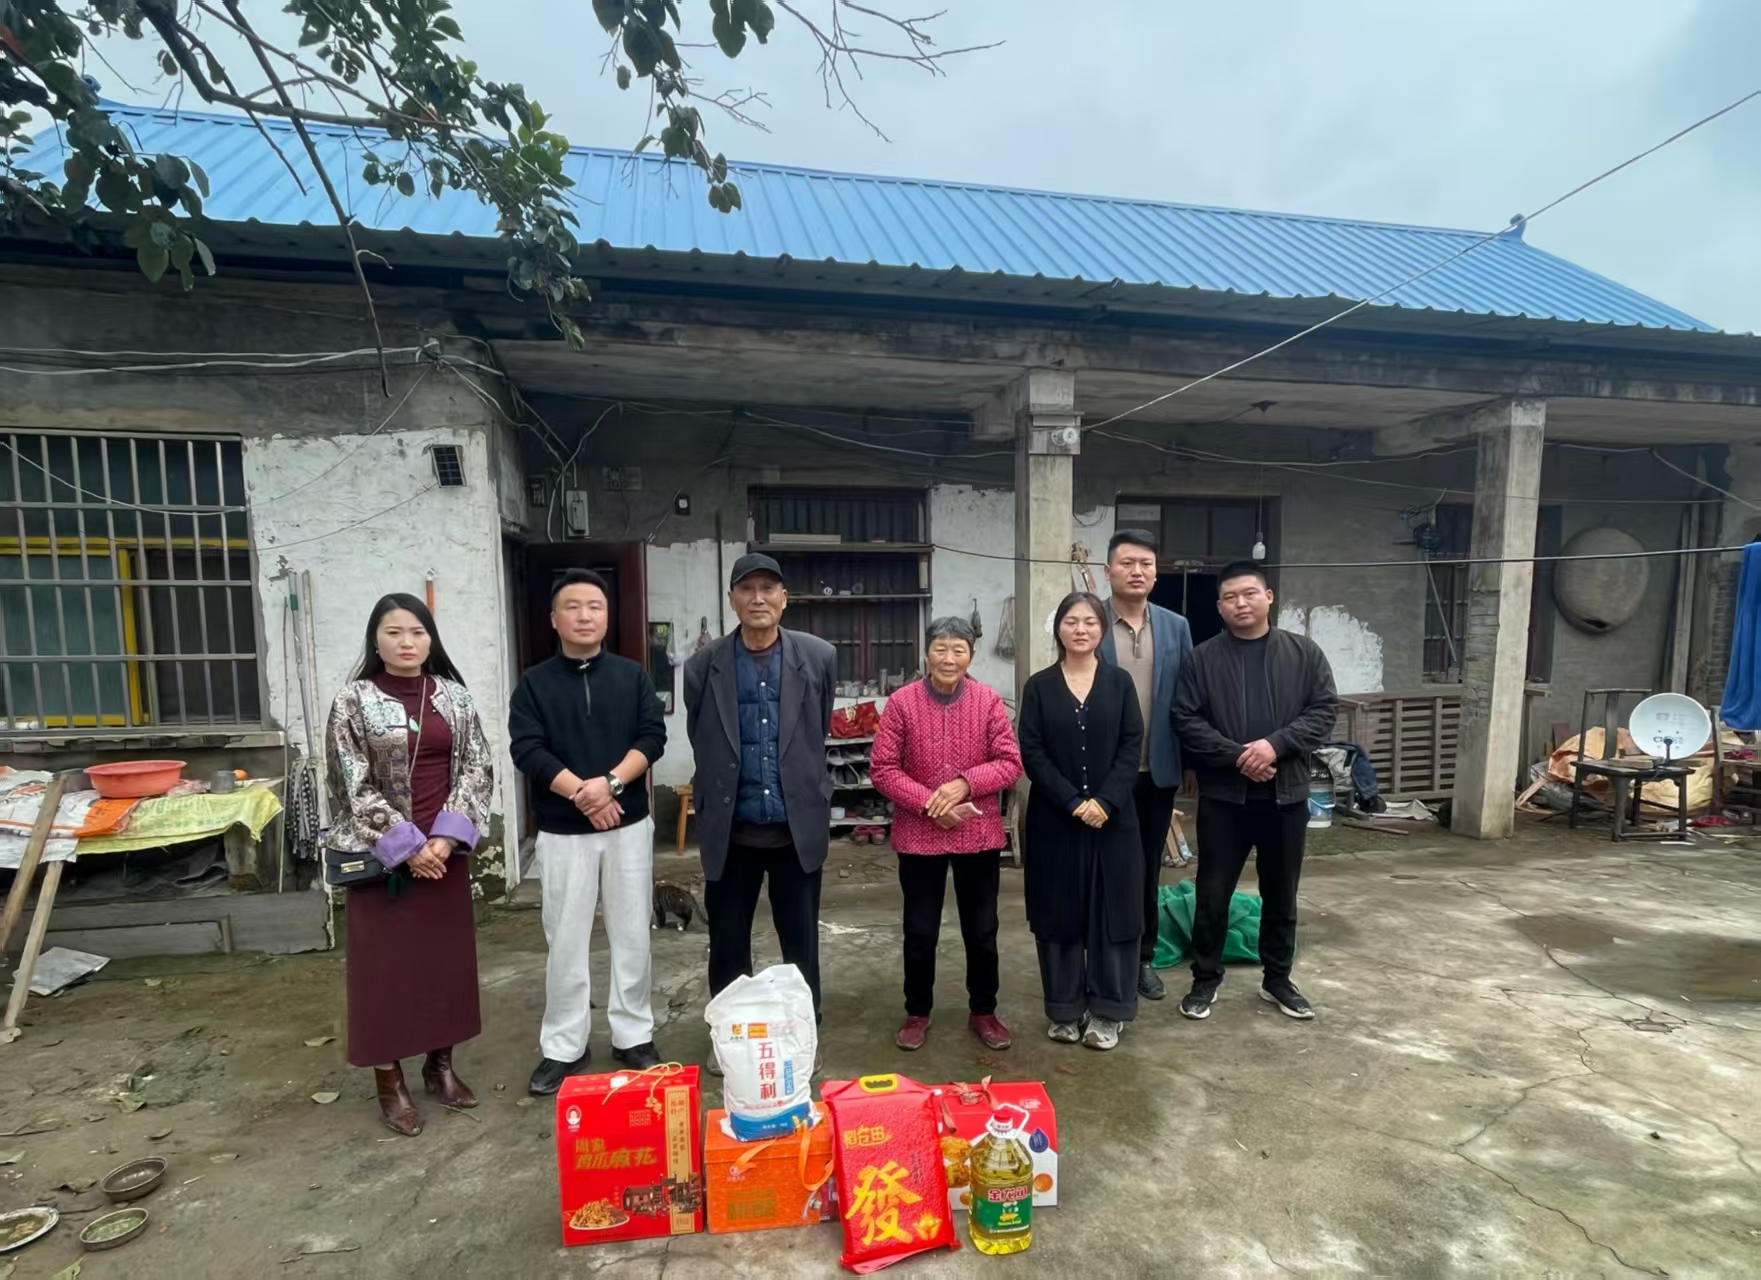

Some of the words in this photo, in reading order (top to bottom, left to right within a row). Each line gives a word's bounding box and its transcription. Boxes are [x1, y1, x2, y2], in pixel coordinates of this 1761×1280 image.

[758, 1042, 776, 1100] 五得利
[988, 1186, 1028, 1202] 金龙鱼
